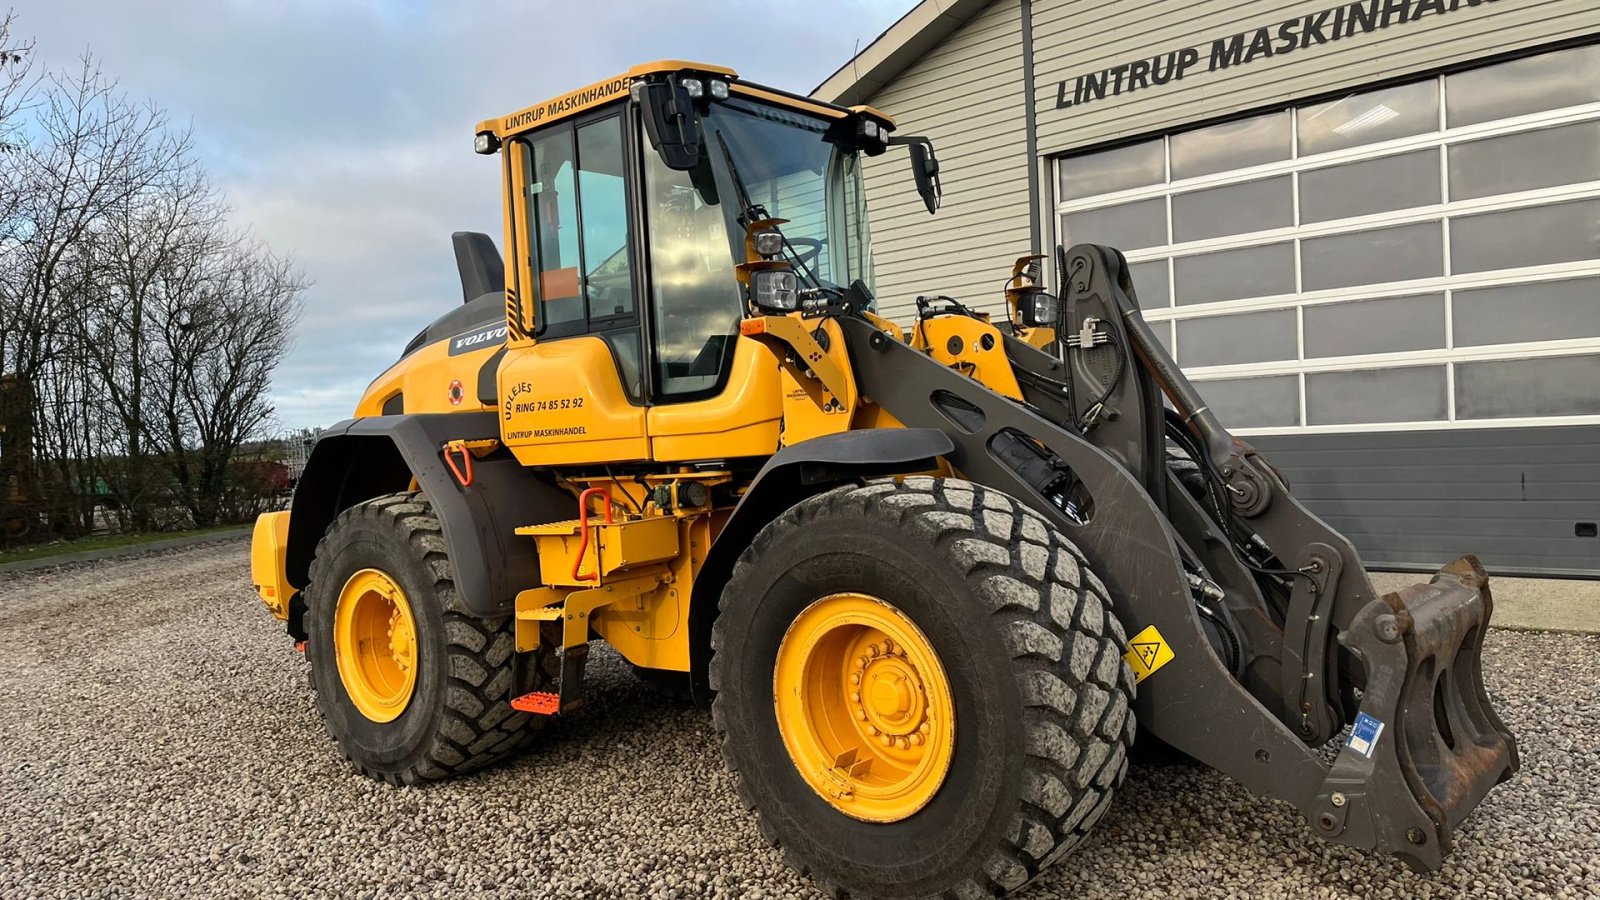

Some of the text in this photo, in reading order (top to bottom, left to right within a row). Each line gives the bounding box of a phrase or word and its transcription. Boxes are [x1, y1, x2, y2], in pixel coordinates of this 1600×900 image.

[1056, 48, 1198, 109] LINTRUP
[505, 107, 545, 131] LINTRUP
[456, 327, 507, 348] VOLVO
[505, 382, 532, 420] UDLEJES
[516, 397, 583, 413] RING 74 85 52 92
[507, 426, 587, 440] LINTRUP MASKINHANDEL
